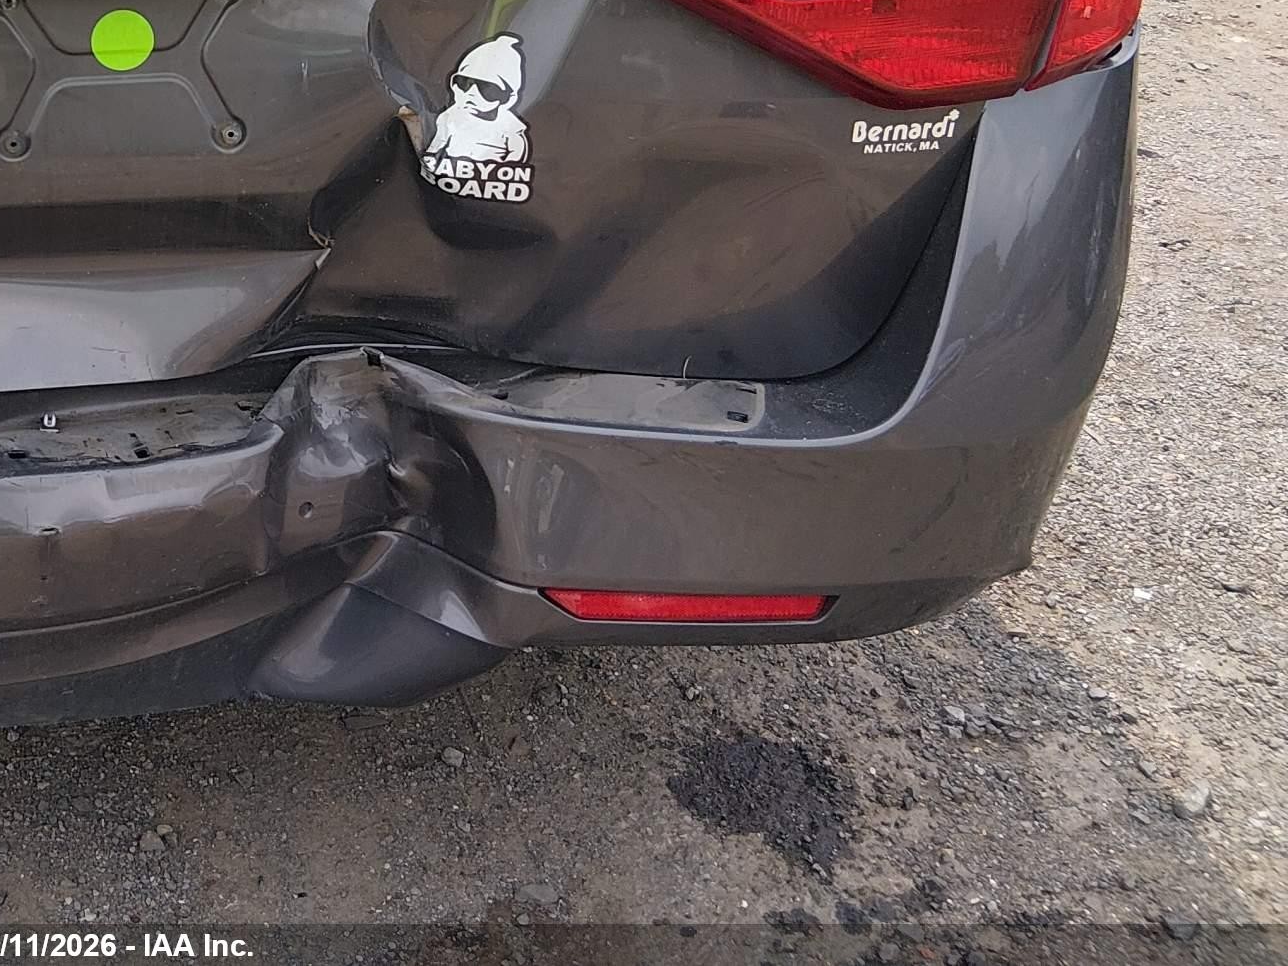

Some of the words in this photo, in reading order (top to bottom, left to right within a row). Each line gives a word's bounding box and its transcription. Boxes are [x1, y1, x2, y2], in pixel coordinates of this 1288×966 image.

[852, 109, 960, 143] Bernardi
[863, 142, 917, 154] NATICK,
[918, 140, 940, 151] MA
[422, 155, 497, 181] BABY
[497, 166, 531, 182] ON
[420, 170, 530, 202] BOARD
